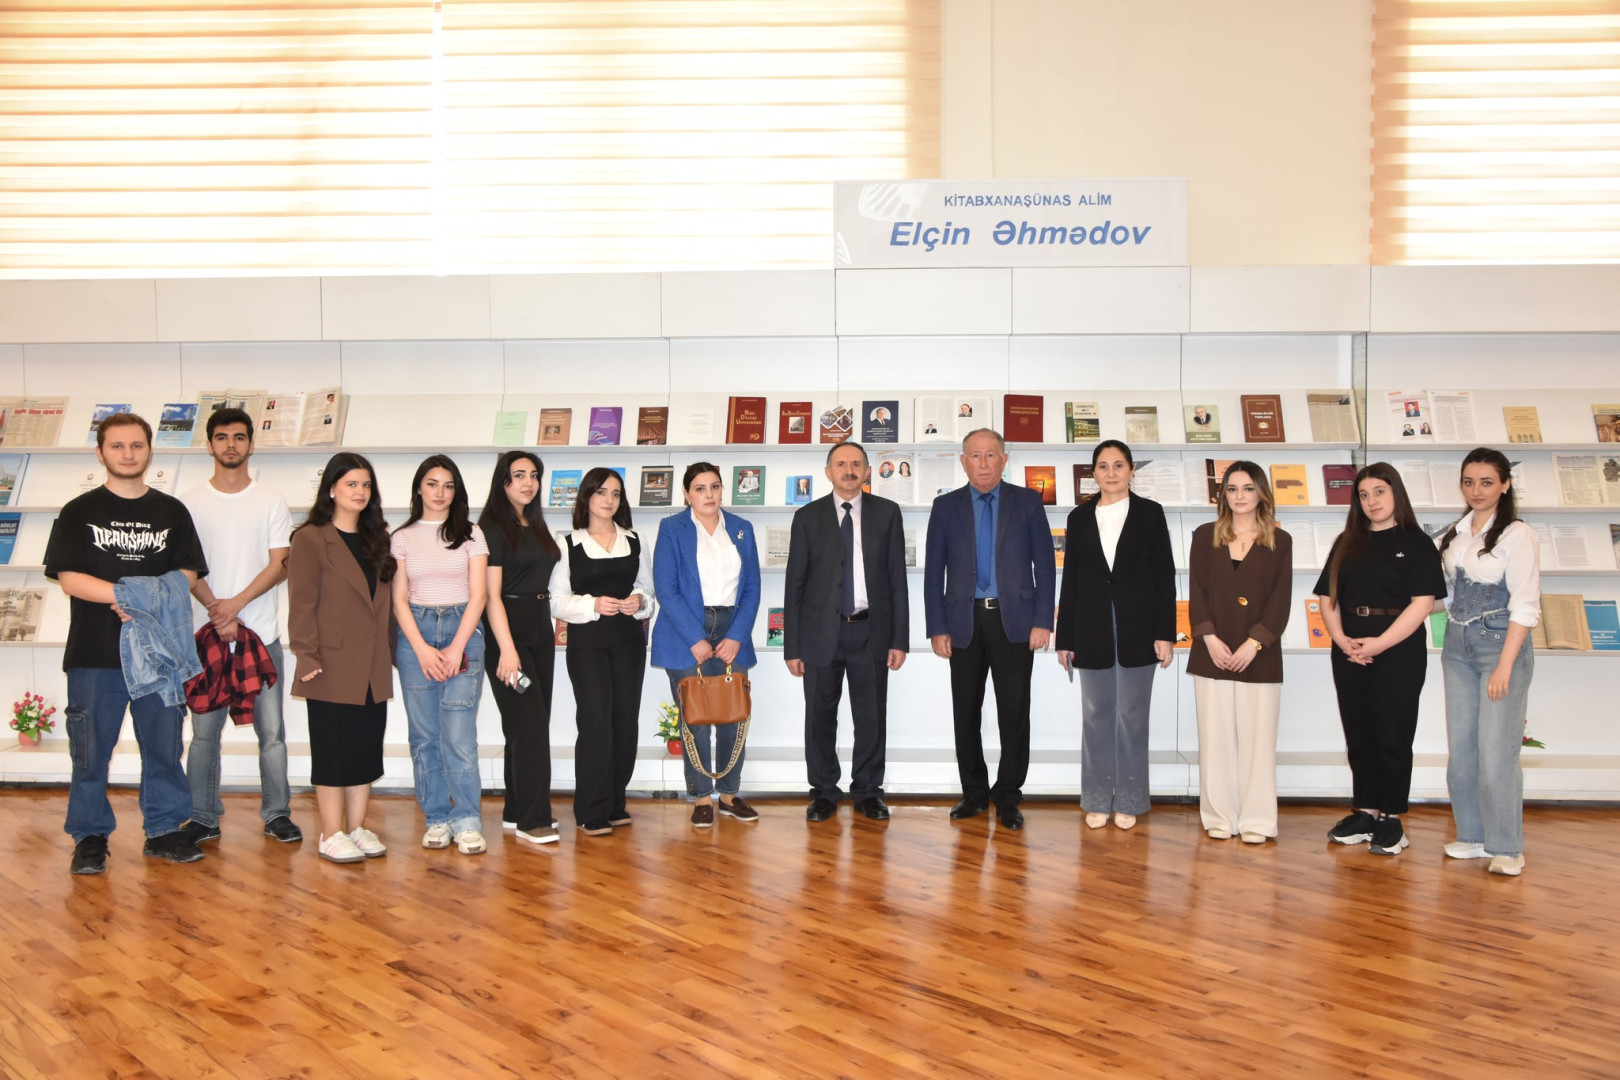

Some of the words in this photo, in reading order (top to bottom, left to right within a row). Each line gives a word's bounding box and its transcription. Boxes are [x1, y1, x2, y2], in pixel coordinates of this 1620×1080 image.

[944, 193, 1072, 208] KİTABXANAŞÜNAS
[1078, 192, 1112, 206] ALİM
[890, 222, 970, 252] Elçin
[993, 220, 1151, 246] Əhmədov
[86, 523, 172, 553] DEADSHINE
